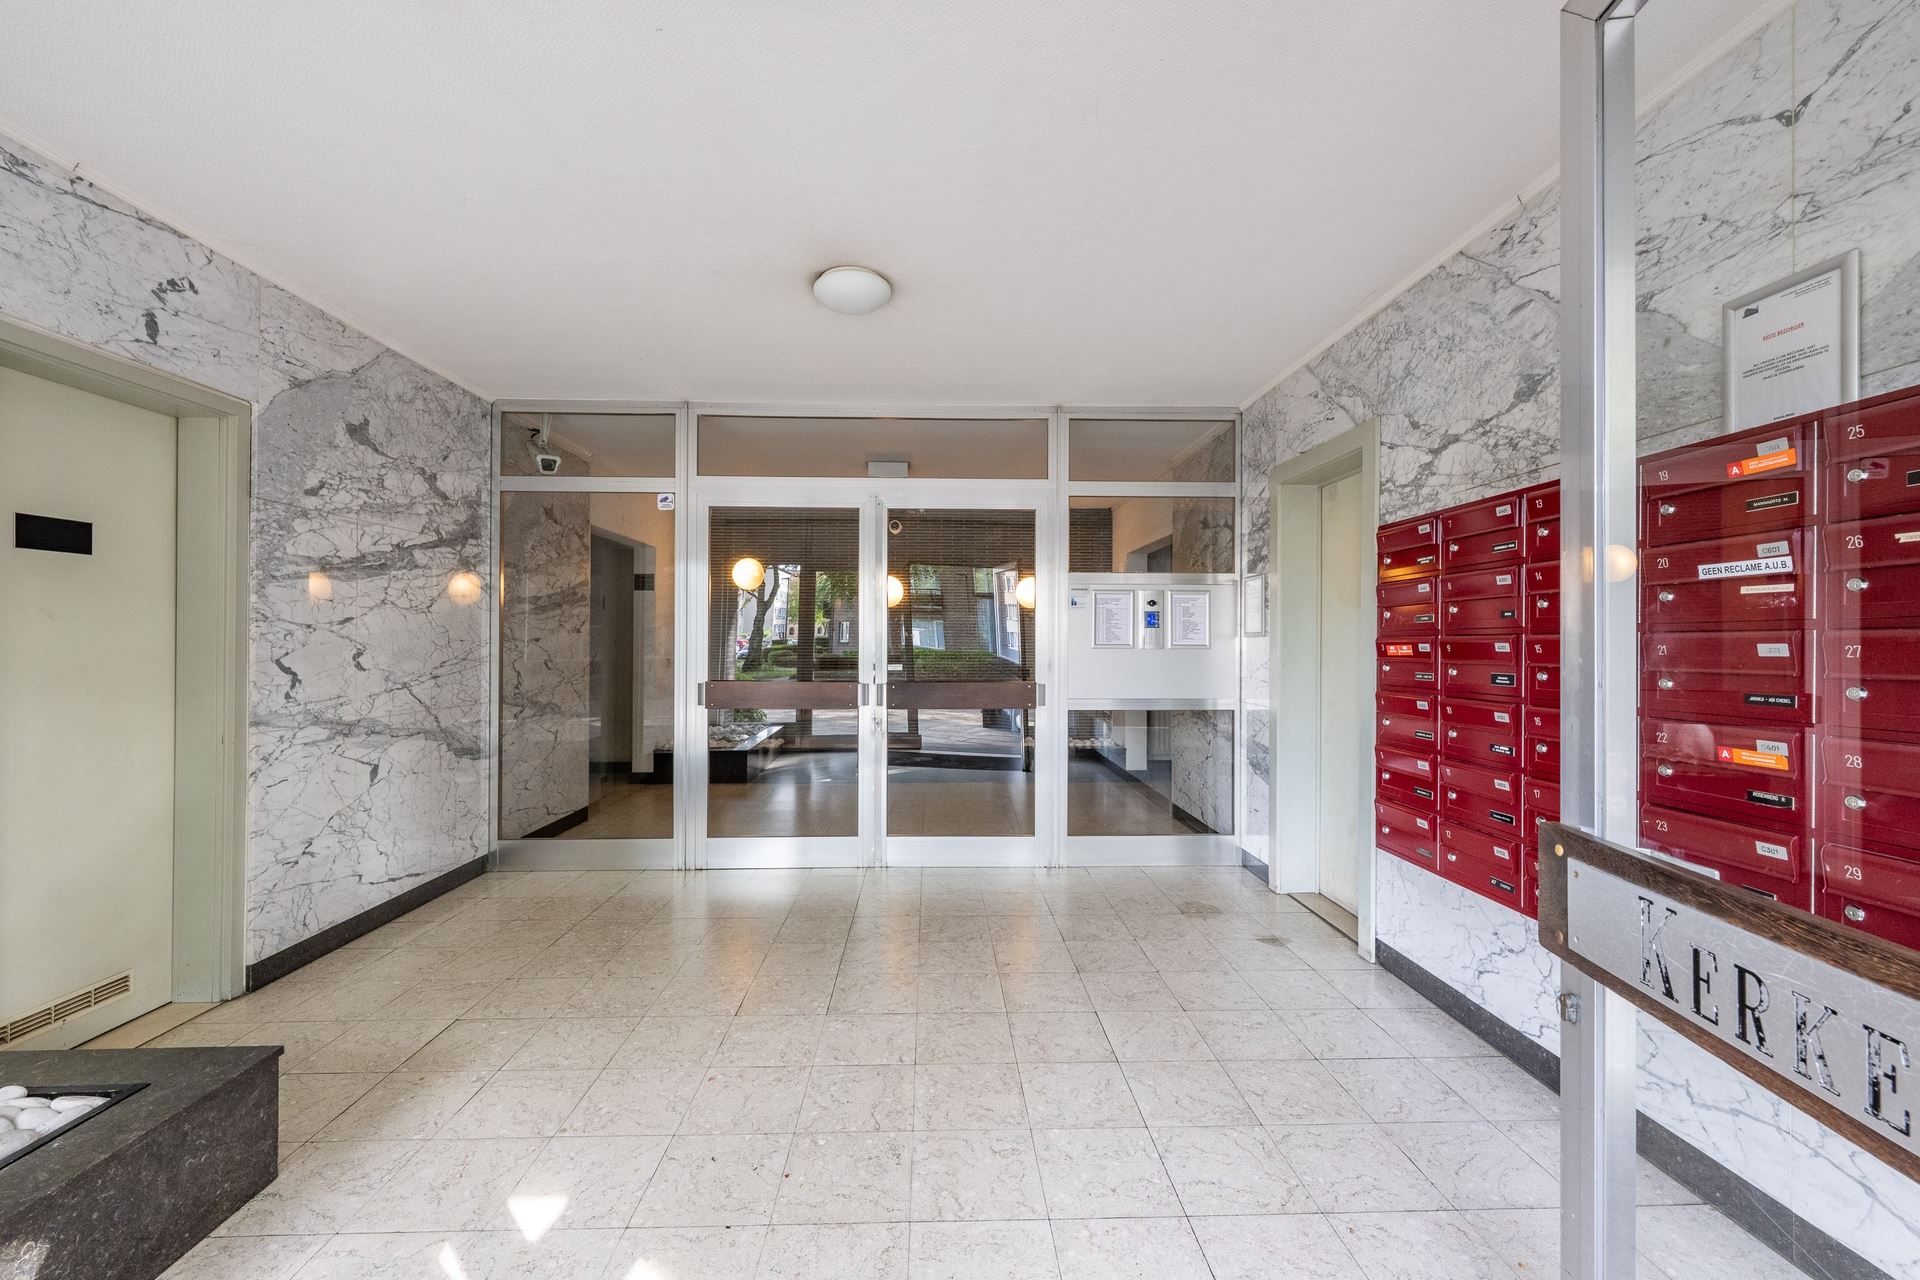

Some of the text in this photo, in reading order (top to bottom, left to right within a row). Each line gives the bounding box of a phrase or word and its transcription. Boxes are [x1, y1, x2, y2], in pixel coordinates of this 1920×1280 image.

[1847, 424, 1865, 440] 25
[1658, 470, 1669, 482] 19
[1535, 499, 1543, 509] 13
[1846, 535, 1864, 549] 26
[1761, 545, 1780, 555] C601
[1657, 557, 1669, 569] 20
[1701, 559, 1790, 577] GEEN RECLAME A.U.B.
[1534, 571, 1543, 581] 14
[1447, 582, 1452, 591] 8
[1534, 644, 1543, 654] 15
[1657, 644, 1668, 656] 21
[1845, 644, 1862, 658] 27
[1533, 716, 1542, 726] 16
[1656, 732, 1668, 744] 22
[1844, 754, 1863, 769] 28
[1533, 789, 1541, 799] 17
[1655, 819, 1669, 832] 23
[1446, 829, 1452, 839] 12
[1760, 845, 1779, 855] C301
[1844, 864, 1863, 881] 29
[1638, 895, 1911, 1138] KERKE
